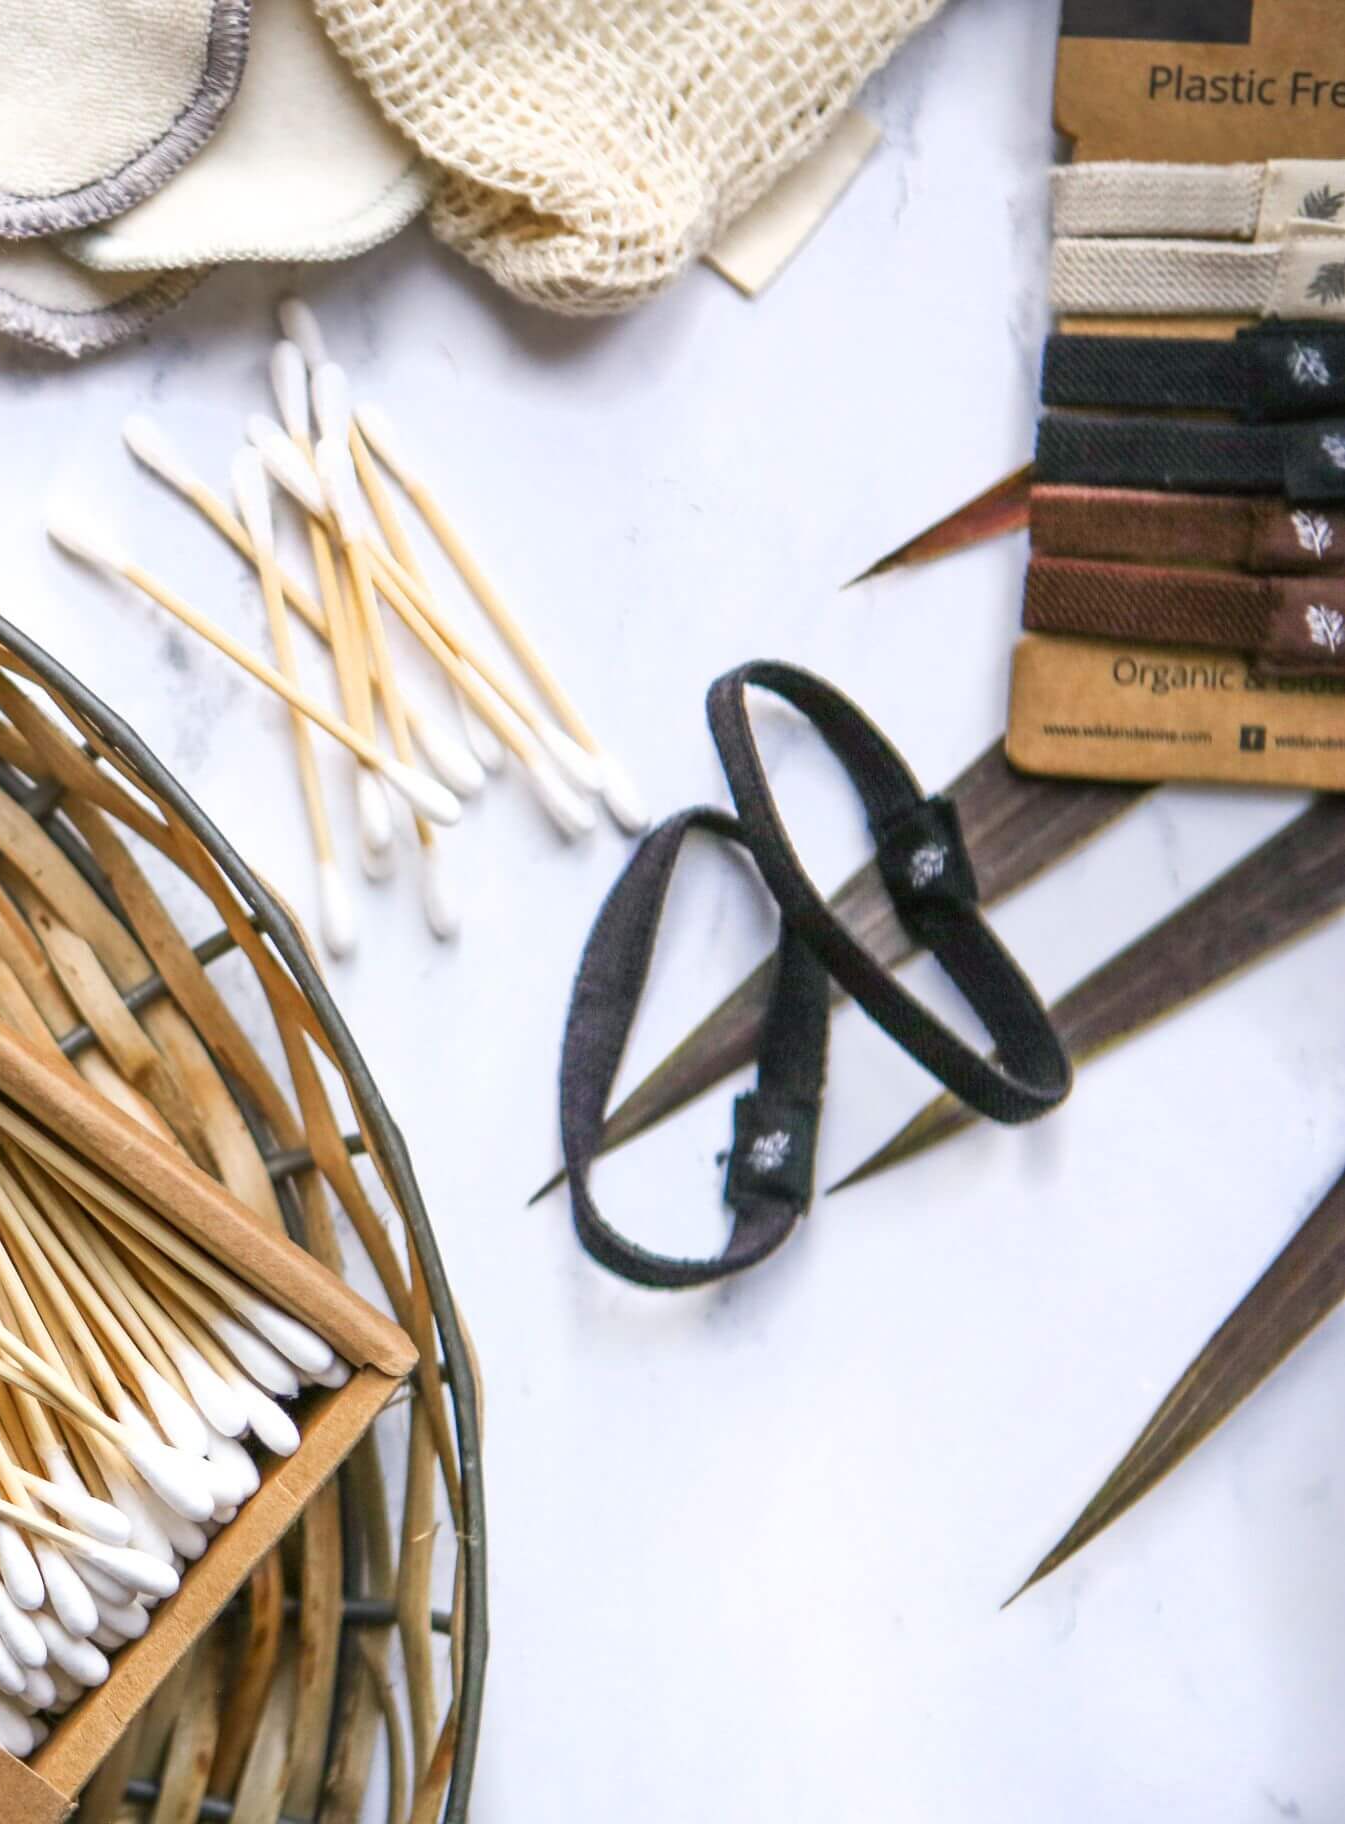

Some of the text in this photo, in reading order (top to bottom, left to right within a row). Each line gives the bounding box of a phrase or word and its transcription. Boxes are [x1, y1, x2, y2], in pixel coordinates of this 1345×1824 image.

[1148, 64, 1345, 109] Plastic Fre
[1112, 656, 1235, 693] Organic
